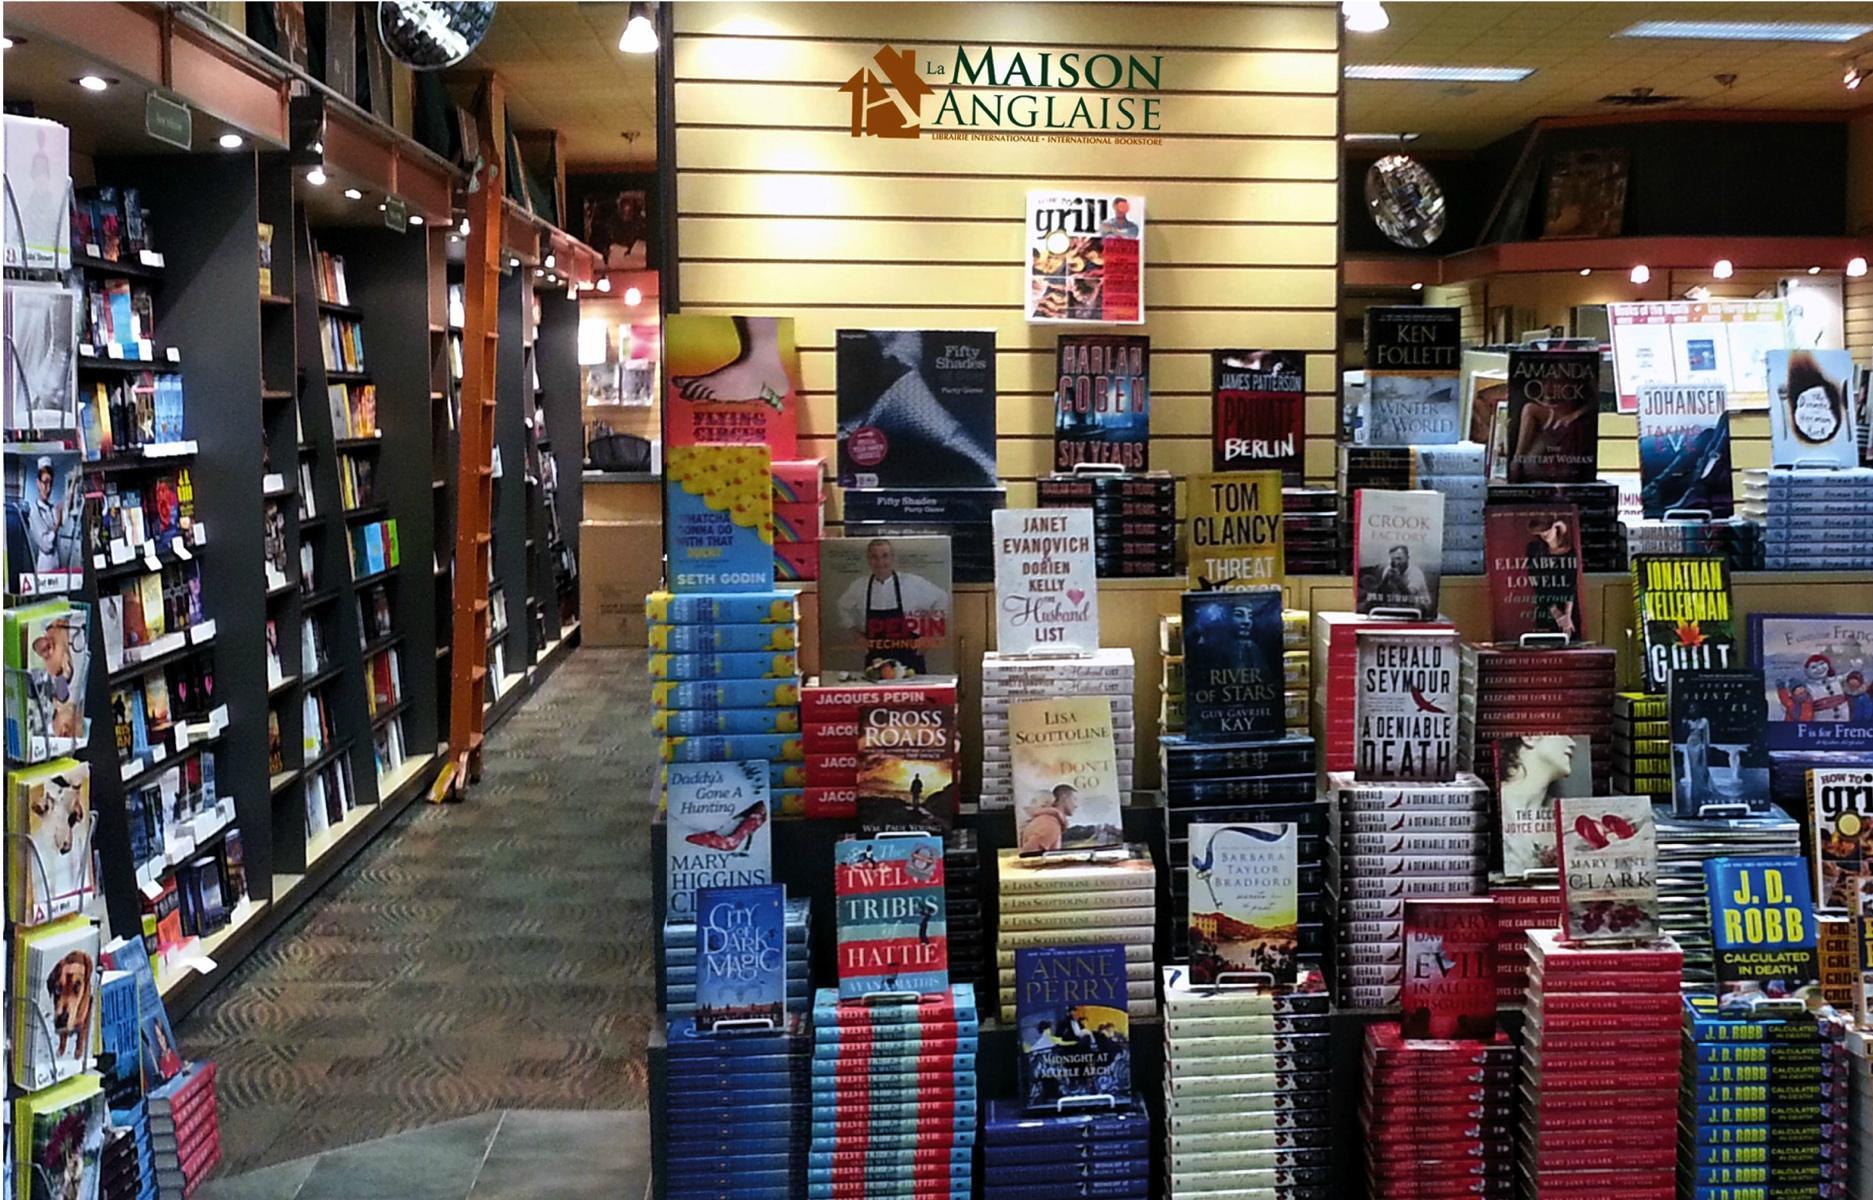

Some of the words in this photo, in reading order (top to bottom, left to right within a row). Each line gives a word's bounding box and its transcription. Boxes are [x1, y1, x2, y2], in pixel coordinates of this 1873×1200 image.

[927, 61, 945, 76] La
[950, 44, 1164, 91] MAISON
[932, 87, 1161, 130] ANGLAISE
[931, 133, 969, 142] LIBRAIRIE
[971, 134, 1039, 143] INTERNATIONALE
[1047, 135, 1112, 145] INTERNATIONAL
[1114, 137, 1163, 146] BOOKSTORE
[1036, 197, 1108, 240] grill
[1397, 324, 1437, 344] KEN
[944, 345, 980, 360] Fifty
[1063, 346, 1142, 375] HARLAN
[1377, 345, 1455, 366] FOLLETT
[935, 357, 987, 370] Shades
[1513, 361, 1594, 379] AMANDA
[1219, 374, 1250, 391] JAMES
[1252, 374, 1302, 391] PATTERSON
[1059, 375, 1145, 414] COBEN
[1523, 380, 1584, 406] QUICK
[1377, 401, 1439, 415] WINTER
[1644, 390, 1725, 416] JOHANSEN
[692, 412, 766, 427] FLYING
[1391, 416, 1454, 434] WORLD
[692, 428, 766, 442] CIRCUS
[1646, 424, 1700, 437] TAKING
[1058, 440, 1089, 467] SIX
[1091, 441, 1143, 468] YEARS
[1224, 433, 1295, 461] BERLIN
[1557, 454, 1593, 463] WOMAN
[877, 497, 900, 507] Fifty
[901, 496, 937, 505] Shades
[1211, 483, 1258, 512] TOM
[1022, 516, 1068, 534] JANET
[1193, 514, 1279, 545] CLANCY
[1368, 514, 1430, 530] CROOK
[707, 536, 733, 546] THAT
[1370, 530, 1427, 542] FACTORY
[1003, 537, 1089, 554] EVANOVICH
[1022, 561, 1070, 576] DORIEN
[1205, 556, 1275, 581] THREAT
[1495, 556, 1577, 571] ELIZABETH
[677, 574, 715, 585] SETH
[720, 573, 766, 584] GODIN
[1507, 574, 1570, 588] LOWELL
[1646, 561, 1723, 590] JONATHAN
[1029, 578, 1065, 593] KELLY
[1504, 592, 1575, 604] dangerous
[1645, 591, 1729, 621] KELLERMAN
[1002, 595, 1090, 627] Husband
[866, 617, 946, 639] PEPIN
[1035, 627, 1065, 642] LIST
[1376, 645, 1442, 668] GERALD
[1210, 668, 1262, 685] RIVER
[1367, 669, 1450, 693] SEYMOUR
[815, 692, 881, 706] JACQUES
[883, 691, 925, 704] PEPIN
[1195, 689, 1216, 703] OF
[1222, 684, 1276, 702] STARS
[869, 708, 942, 729] CROSS
[1043, 711, 1078, 726] LISA
[1201, 709, 1224, 719] GUY
[1221, 717, 1255, 732] KAY
[1362, 720, 1373, 737] A
[1377, 716, 1450, 739] DENIABLE
[1835, 723, 1873, 739] Frenc
[864, 728, 947, 748] ROADS
[1015, 727, 1110, 745] SCOTTOLINE
[1362, 741, 1450, 776] DEATH
[1060, 760, 1111, 775] DON'T
[671, 771, 724, 787] Daddy's
[1073, 775, 1100, 789] GO
[1821, 773, 1847, 784] HOW
[1848, 773, 1863, 784] TO
[695, 788, 729, 801] Gone
[732, 786, 743, 799] A
[1821, 774, 1873, 822] gri
[680, 801, 735, 817] Hunting
[671, 853, 729, 871] MARY
[1221, 852, 1285, 862] BARBARA
[1570, 859, 1608, 870] MARY
[1615, 858, 1647, 869] JANE
[1227, 865, 1280, 874] TAYLOR
[672, 869, 765, 890] HIGGINS
[1215, 878, 1292, 888] BRADFORD
[1568, 871, 1650, 890] CLARK
[846, 895, 939, 920] TRIBES
[709, 902, 760, 932] CITY
[1723, 907, 1804, 944] ROBB
[702, 925, 770, 955] DARK
[847, 943, 940, 968] HATTIE
[1724, 952, 1810, 964] CALCULATED
[1031, 954, 1115, 980] ANNE
[1414, 951, 1491, 979] EVIL
[1738, 966, 1753, 975] IN
[1755, 965, 1798, 975] DEATH
[1026, 977, 1119, 1003] PERRY
[1413, 983, 1431, 994] IN
[102, 985, 134, 1025] UILTY
[1733, 1026, 1762, 1040] ROBB
[1042, 1053, 1093, 1065] MIDNIGHT
[1097, 1052, 1108, 1062] AT
[1736, 1048, 1765, 1062] ROBB
[1041, 1066, 1079, 1078] MARBLE
[1083, 1065, 1110, 1077] ARCH
[1737, 1067, 1767, 1081] ROBB
